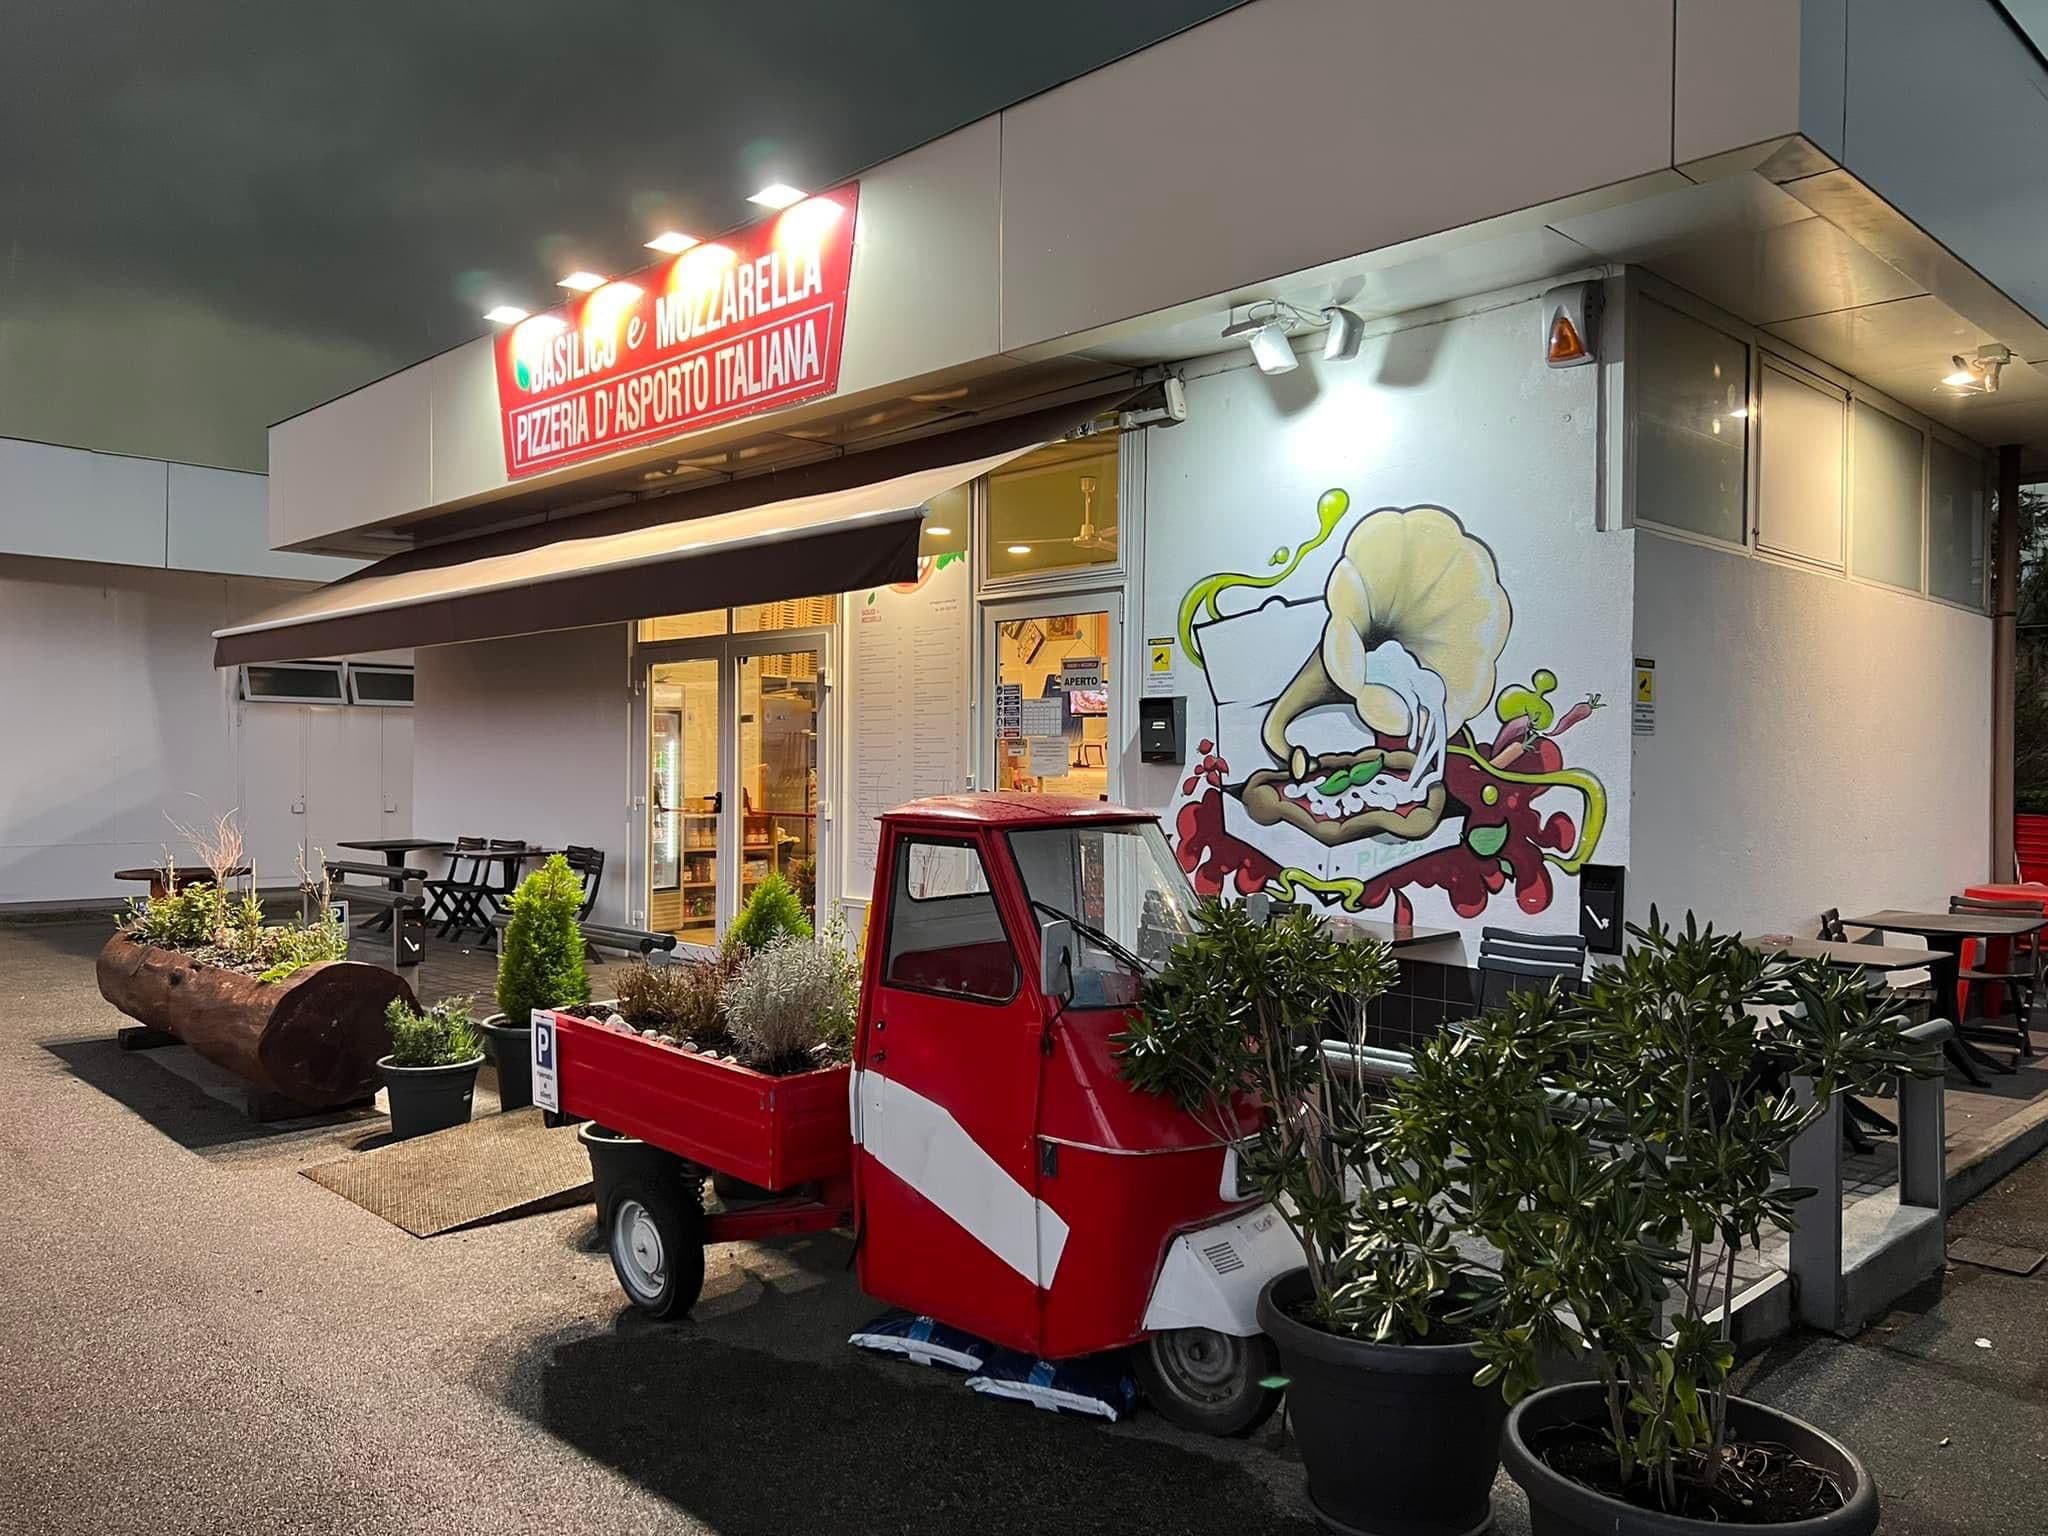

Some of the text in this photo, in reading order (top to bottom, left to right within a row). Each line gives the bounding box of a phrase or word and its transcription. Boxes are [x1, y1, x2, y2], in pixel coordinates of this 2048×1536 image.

[529, 246, 822, 395] BASILICO e MOZZARELLA
[516, 320, 820, 461] PIZZERIA D'ASPORTO ITALIANA
[1064, 676, 1098, 686] APERTO
[537, 1026, 549, 1063] P
